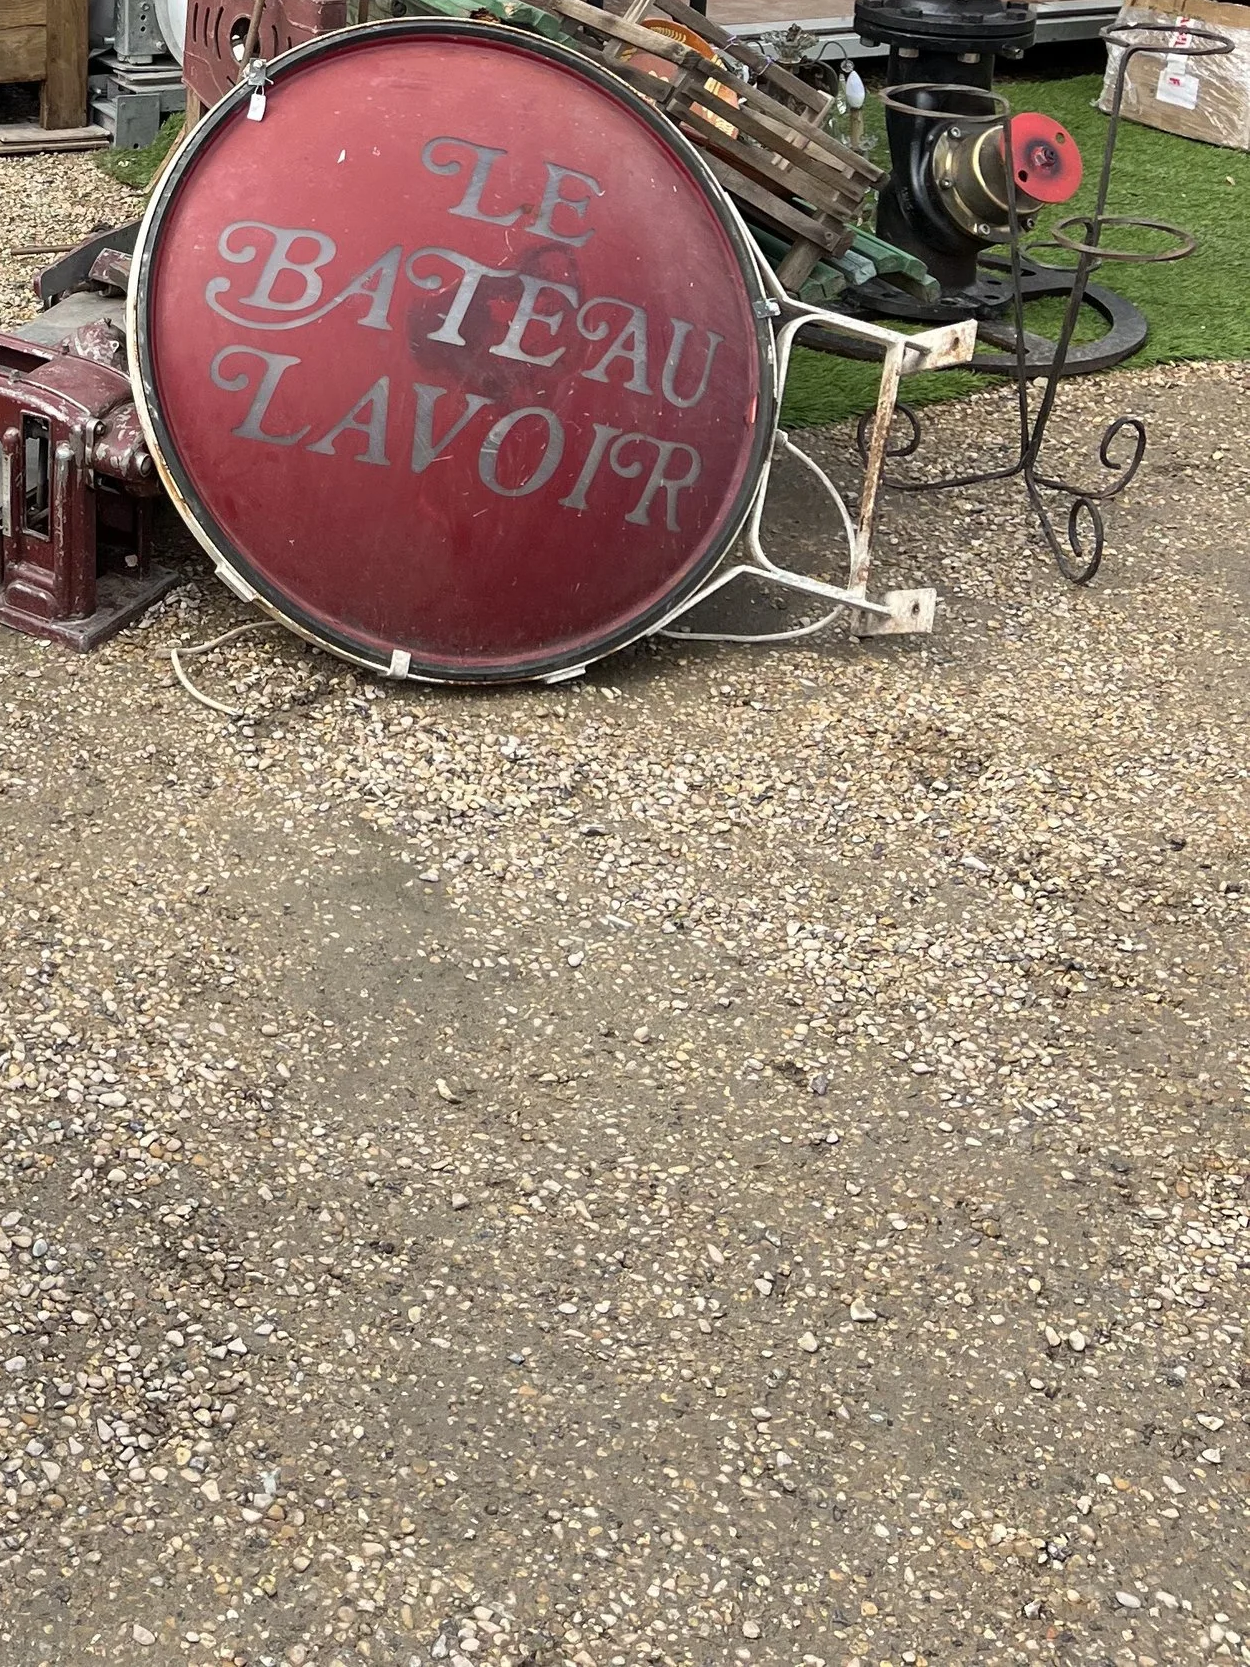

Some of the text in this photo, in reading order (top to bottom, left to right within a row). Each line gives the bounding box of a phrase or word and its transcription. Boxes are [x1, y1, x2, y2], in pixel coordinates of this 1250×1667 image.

[422, 136, 606, 248] LE
[205, 221, 725, 409] BATEAU
[210, 344, 703, 533] LAVOIR
